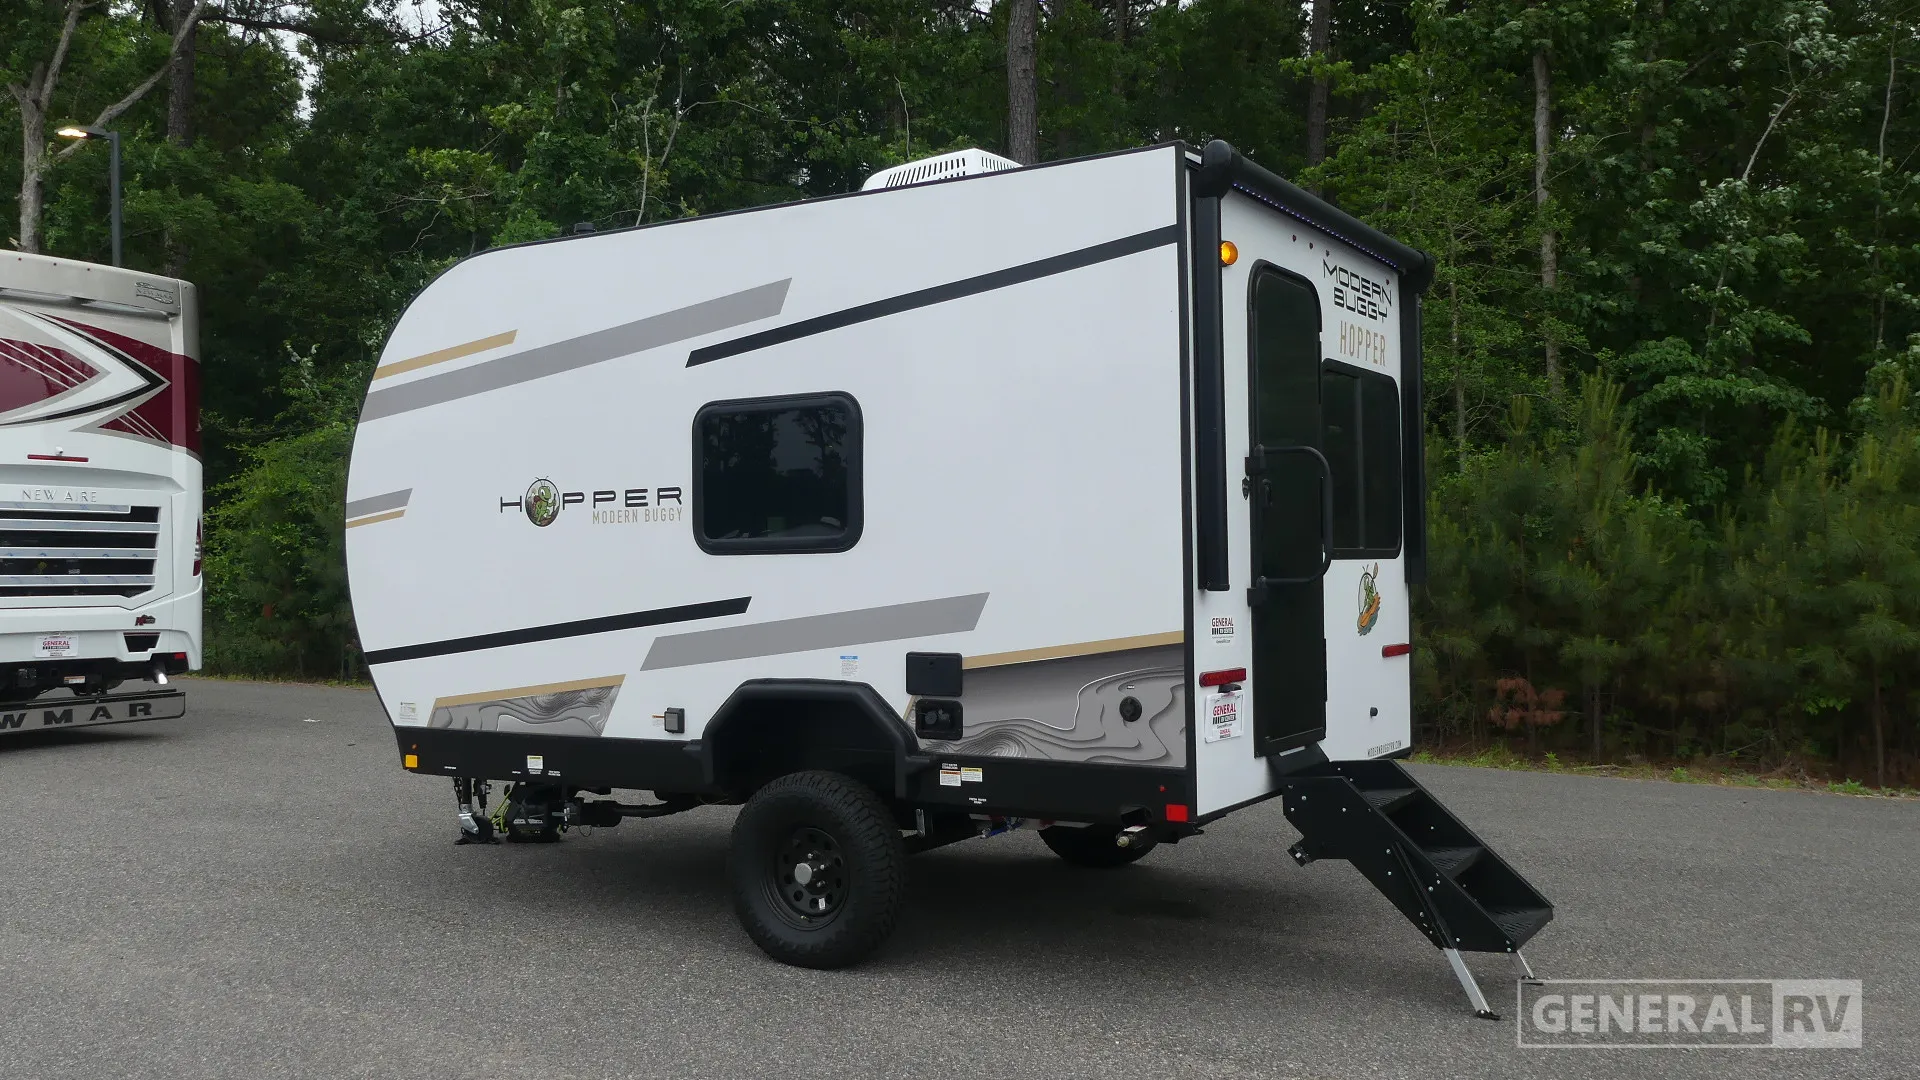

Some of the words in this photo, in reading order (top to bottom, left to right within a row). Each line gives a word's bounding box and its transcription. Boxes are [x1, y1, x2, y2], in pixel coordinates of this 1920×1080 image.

[1323, 258, 1392, 307] MODERN
[1333, 286, 1388, 323] BUGGY
[1340, 320, 1386, 367] HOPPER
[22, 489, 57, 501] NEW
[64, 491, 97, 502] AIRE
[592, 509, 638, 525] MODERN
[644, 507, 683, 523] BUGGY
[1211, 617, 1234, 627] GENERAL
[1212, 703, 1237, 716] GENERAL
